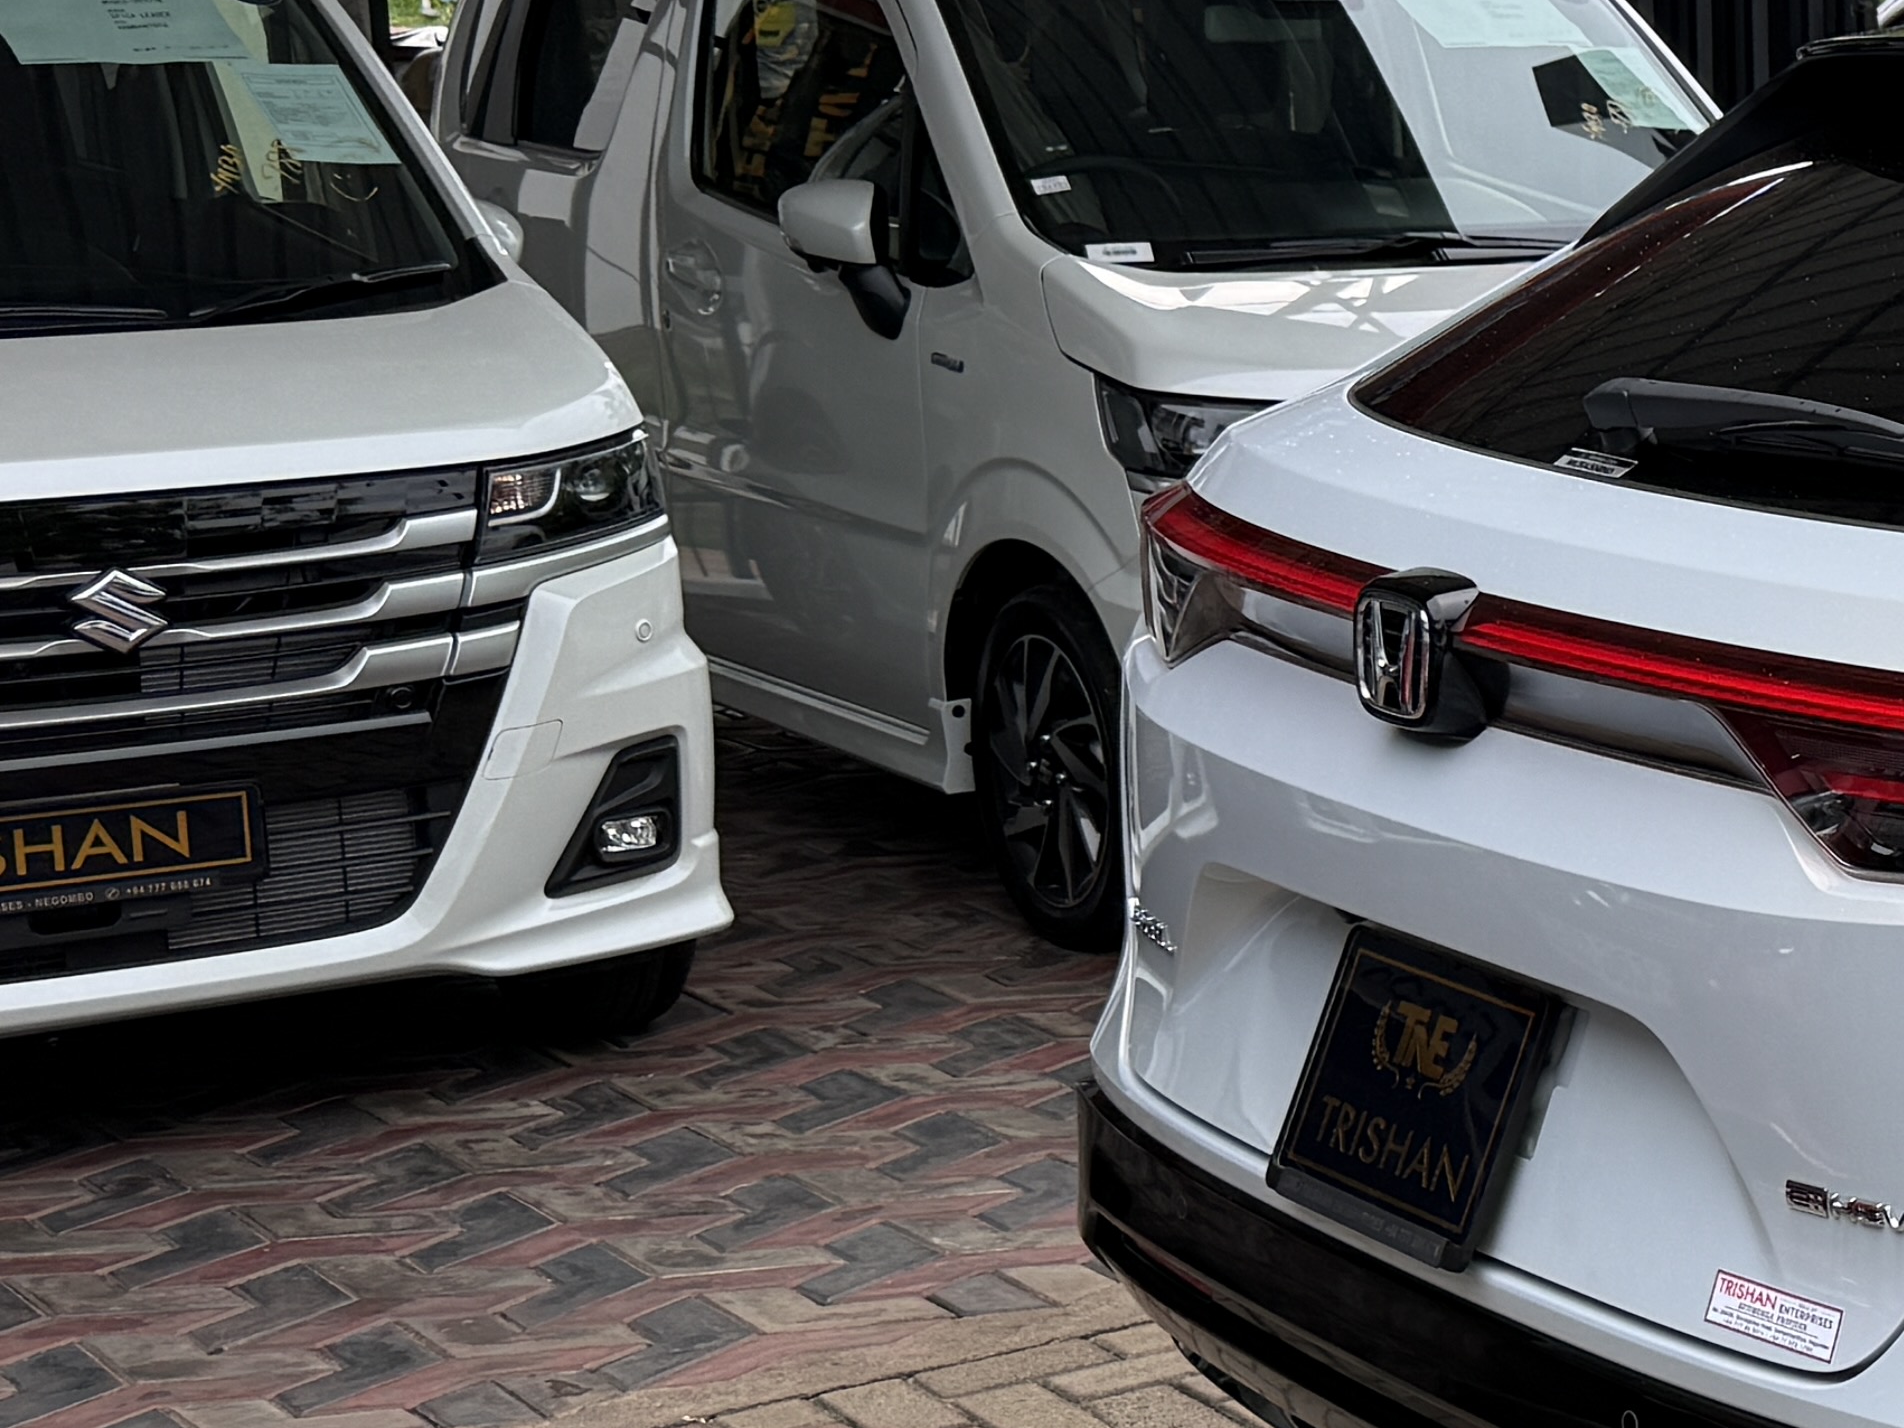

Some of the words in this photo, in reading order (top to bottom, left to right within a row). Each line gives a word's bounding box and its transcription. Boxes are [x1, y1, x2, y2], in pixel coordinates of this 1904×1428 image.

[35, 892, 95, 908] NEGOMBO
[1315, 1094, 1471, 1204] TRISHAN
[1719, 1277, 1778, 1310] TRISHAN
[1778, 1303, 1834, 1330] ENTERPRISES
